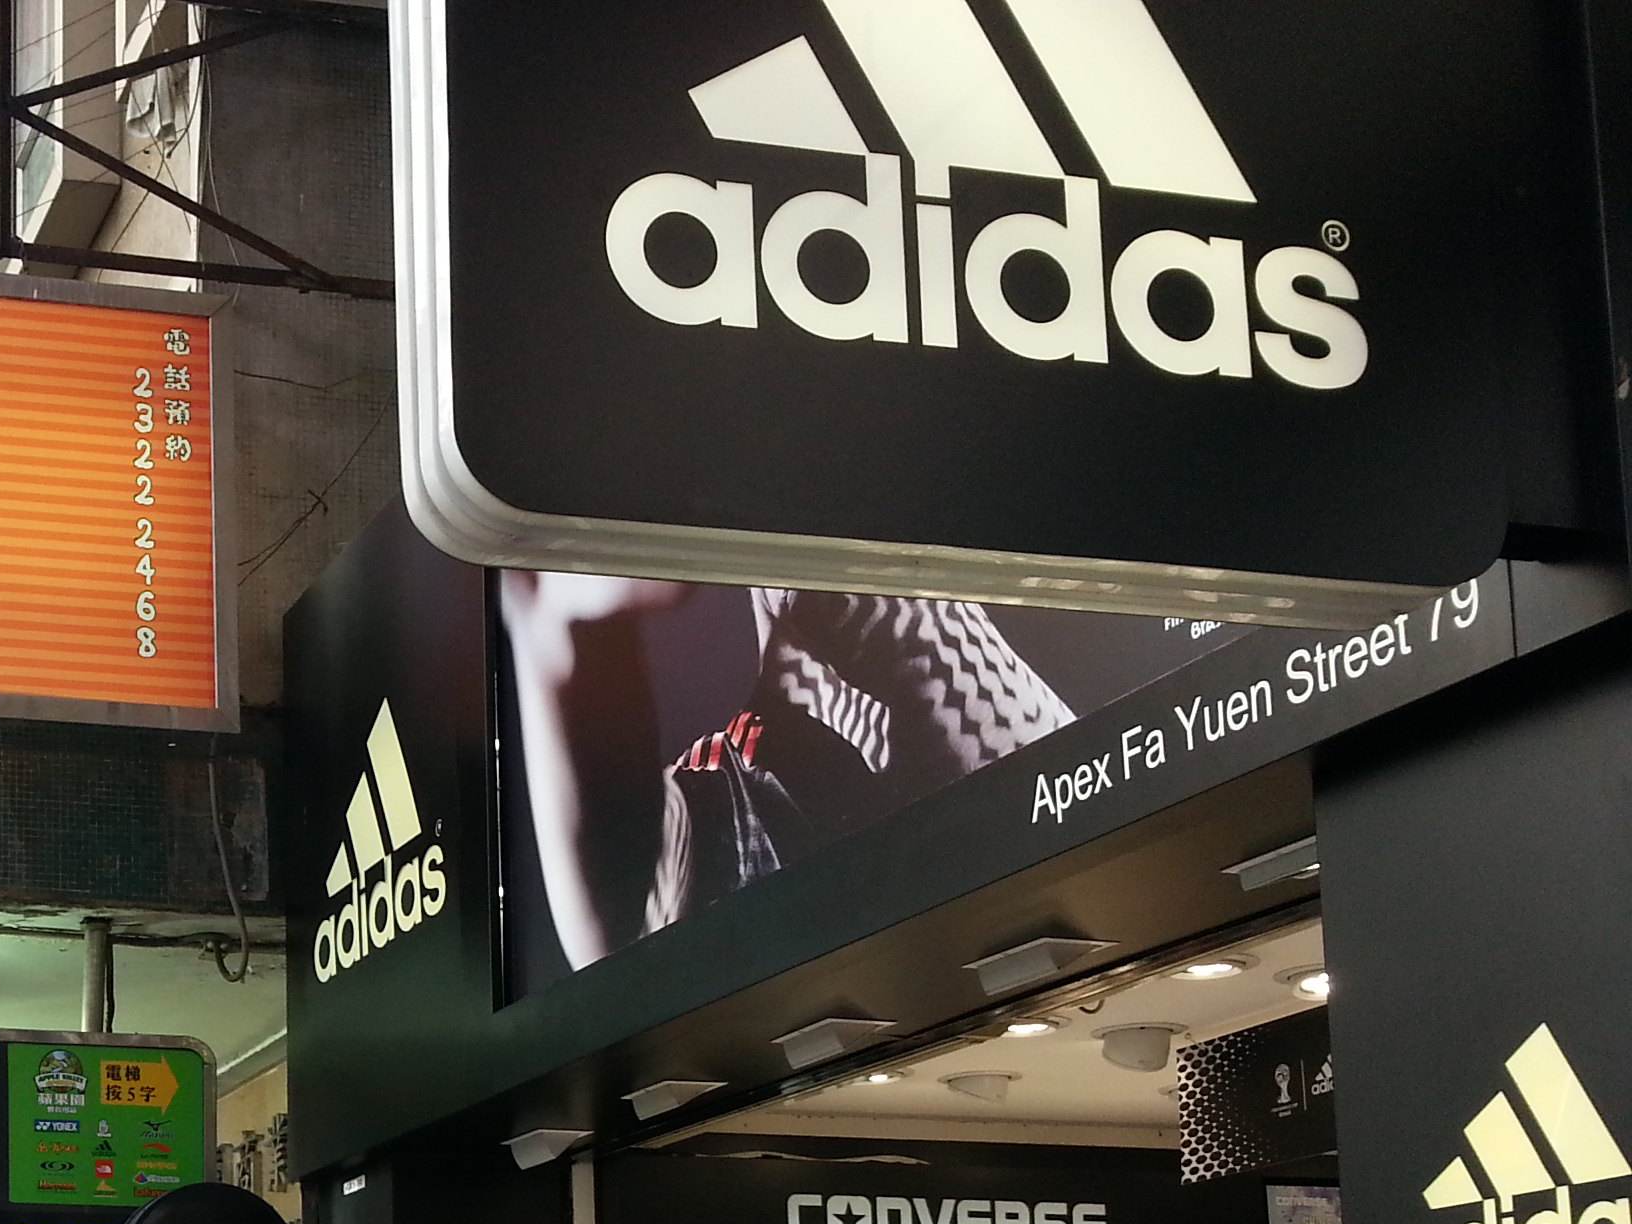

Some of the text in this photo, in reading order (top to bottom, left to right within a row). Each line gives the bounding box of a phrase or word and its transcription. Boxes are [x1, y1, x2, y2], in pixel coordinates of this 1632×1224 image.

[604, 152, 1369, 390] adidas
[162, 327, 193, 463] 電話預約
[1031, 752, 1113, 824] Apex
[1121, 725, 1166, 782] Fa
[1173, 678, 1273, 752] Yuen
[1284, 611, 1412, 705] Street
[313, 844, 447, 984] adidas
[105, 1064, 142, 1082] 電梯
